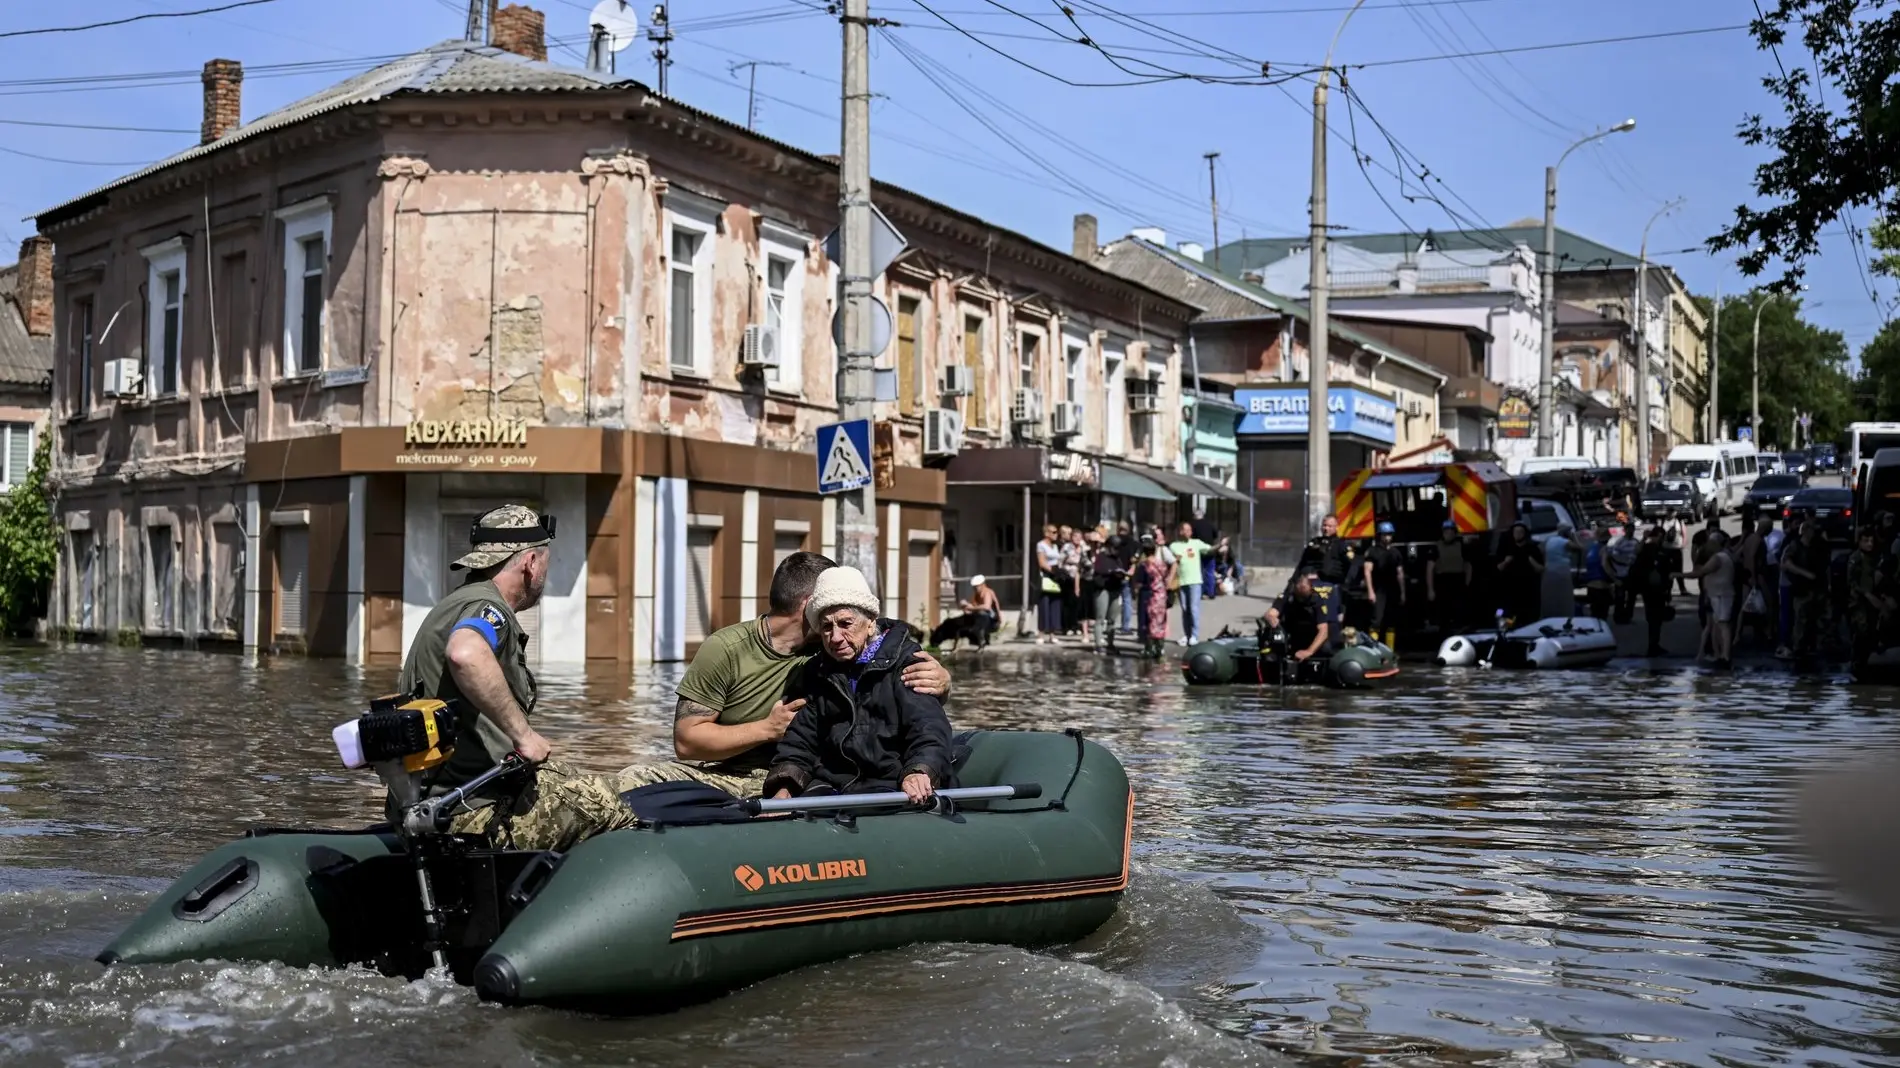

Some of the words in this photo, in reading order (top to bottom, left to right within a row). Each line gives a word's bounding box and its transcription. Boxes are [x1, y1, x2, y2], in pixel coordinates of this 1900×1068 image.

[1250, 396, 1345, 413] ВЕТАПТКА
[405, 417, 527, 443] КОХАНИЙ
[396, 452, 463, 464] текстиль
[468, 454, 494, 467] для
[499, 454, 537, 467] дому
[767, 859, 867, 885] KOLIBRI
